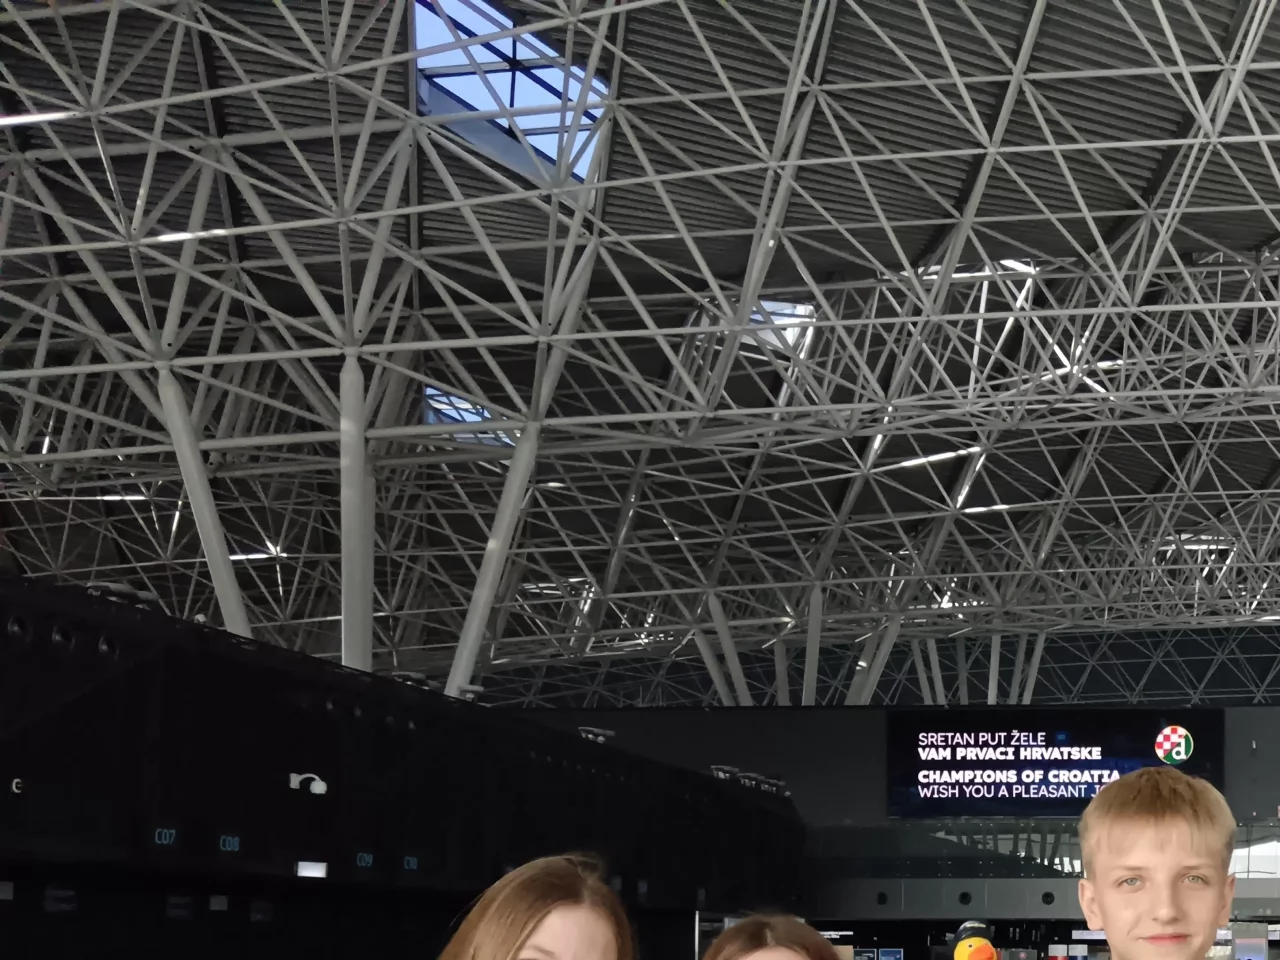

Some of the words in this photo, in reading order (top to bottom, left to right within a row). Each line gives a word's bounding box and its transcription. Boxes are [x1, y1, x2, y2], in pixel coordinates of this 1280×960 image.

[918, 732, 974, 746] SRETAN
[978, 732, 1007, 746] PUT
[1011, 729, 1046, 746] ŽELE
[918, 747, 953, 760] VAM
[956, 747, 1015, 760] PRVACI
[1020, 747, 1102, 760] HRVATSKE
[918, 770, 1017, 784] CHAMPIONS
[1021, 770, 1043, 784] OF
[1047, 770, 1120, 784] CROATIA
[918, 785, 959, 798] WISH
[963, 785, 995, 798] YOU
[998, 785, 1009, 798] A
[1012, 785, 1087, 798] PLEASANT
[155, 828, 176, 844] C07
